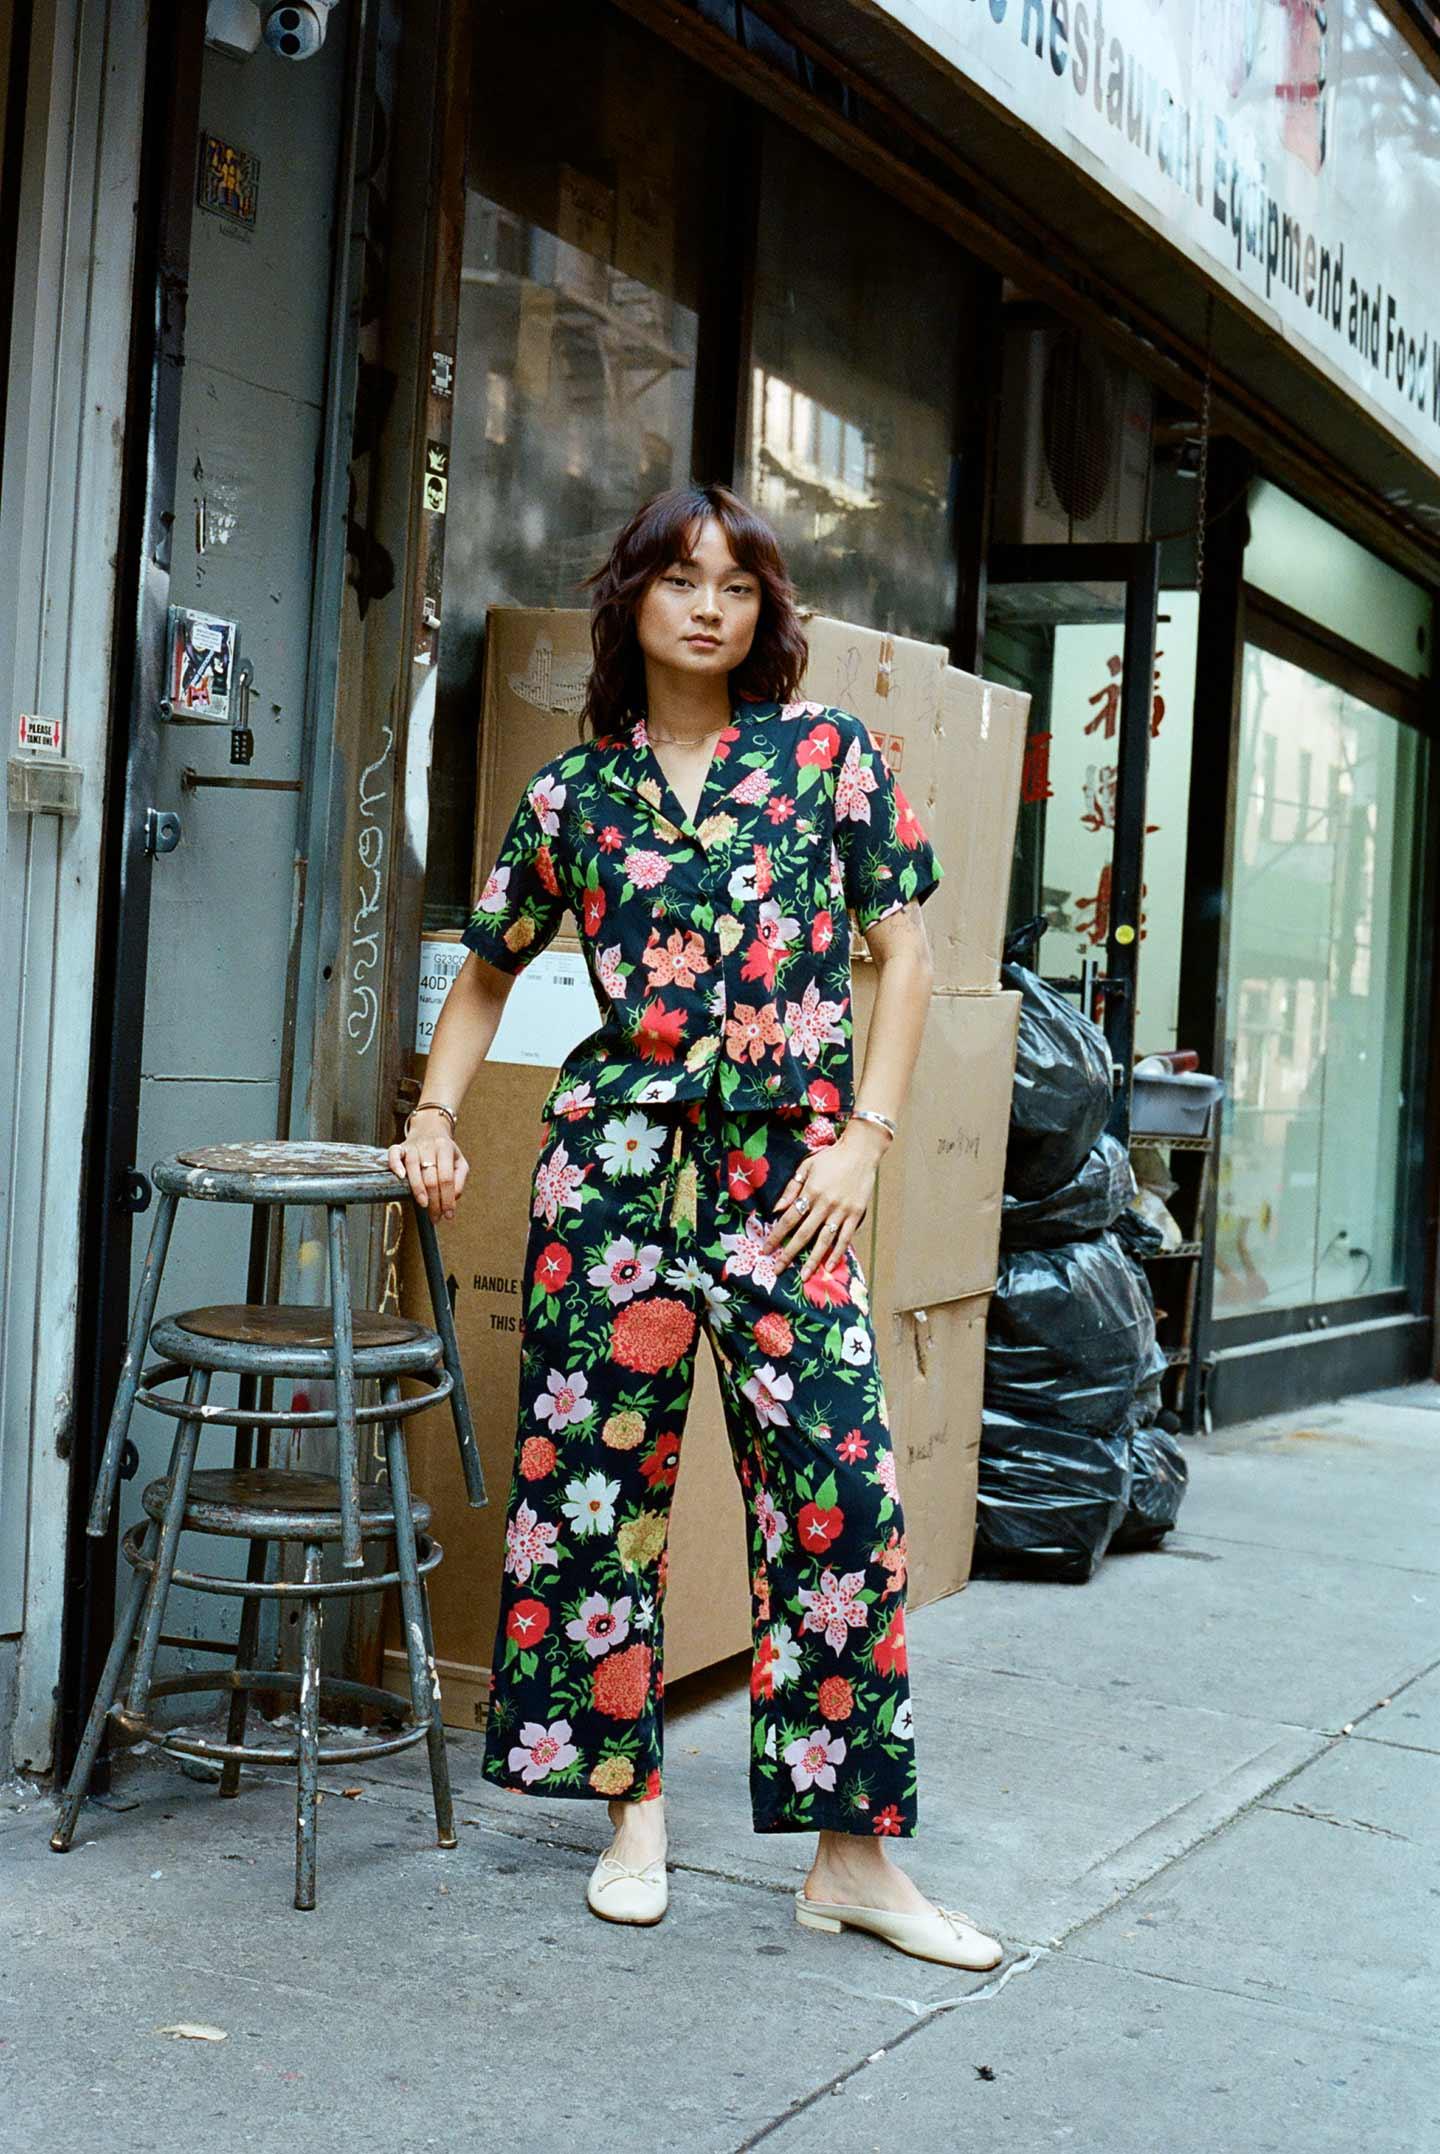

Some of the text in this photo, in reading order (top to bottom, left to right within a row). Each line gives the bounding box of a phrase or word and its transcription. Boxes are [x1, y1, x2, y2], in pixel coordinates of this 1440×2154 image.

[1349, 277, 1381, 370] and
[29, 724, 52, 735] PLEASE
[27, 735, 41, 744] TAKE
[420, 975, 447, 991] 40D
[473, 1274, 518, 1295] HANDLE
[490, 1314, 516, 1333] THIS
